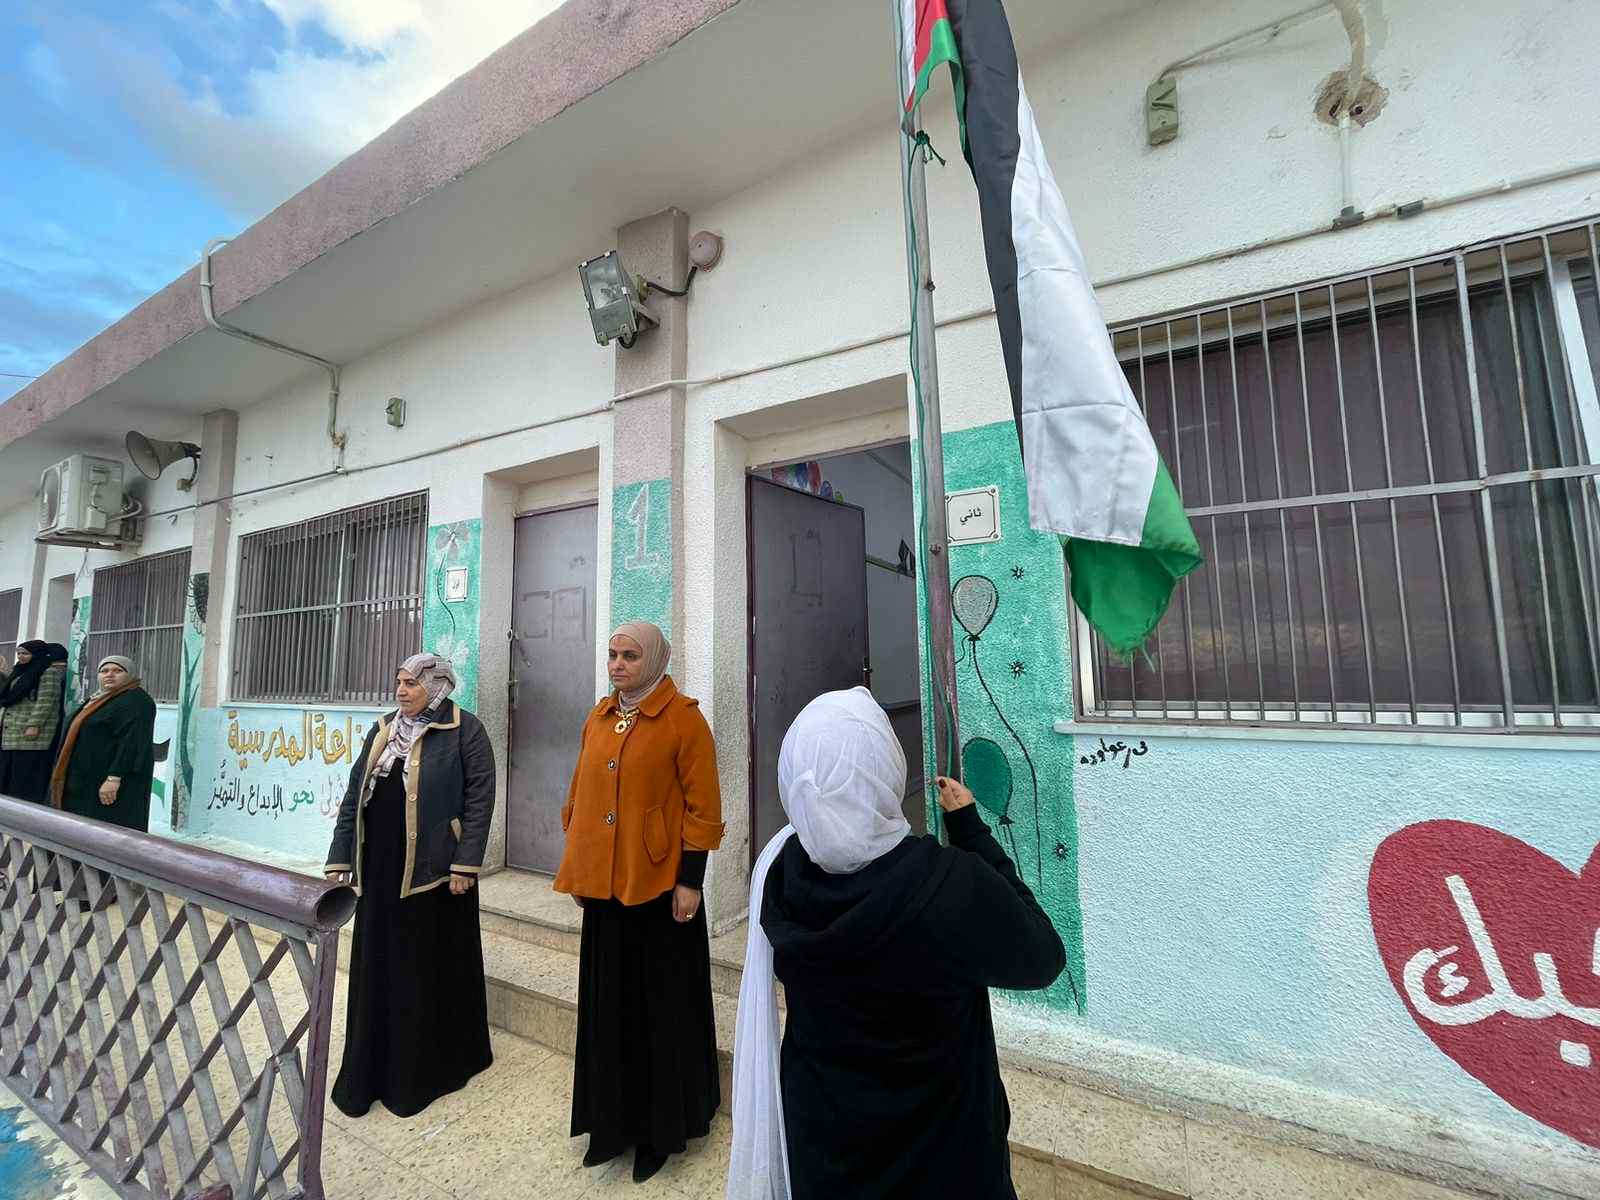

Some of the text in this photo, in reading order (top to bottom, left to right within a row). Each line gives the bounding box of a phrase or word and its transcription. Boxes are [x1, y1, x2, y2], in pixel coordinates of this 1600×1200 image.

[959, 507, 982, 526] ثاني
[227, 709, 314, 771] المدرسية
[247, 783, 284, 820] الإبداع
[288, 779, 315, 812] نحو
